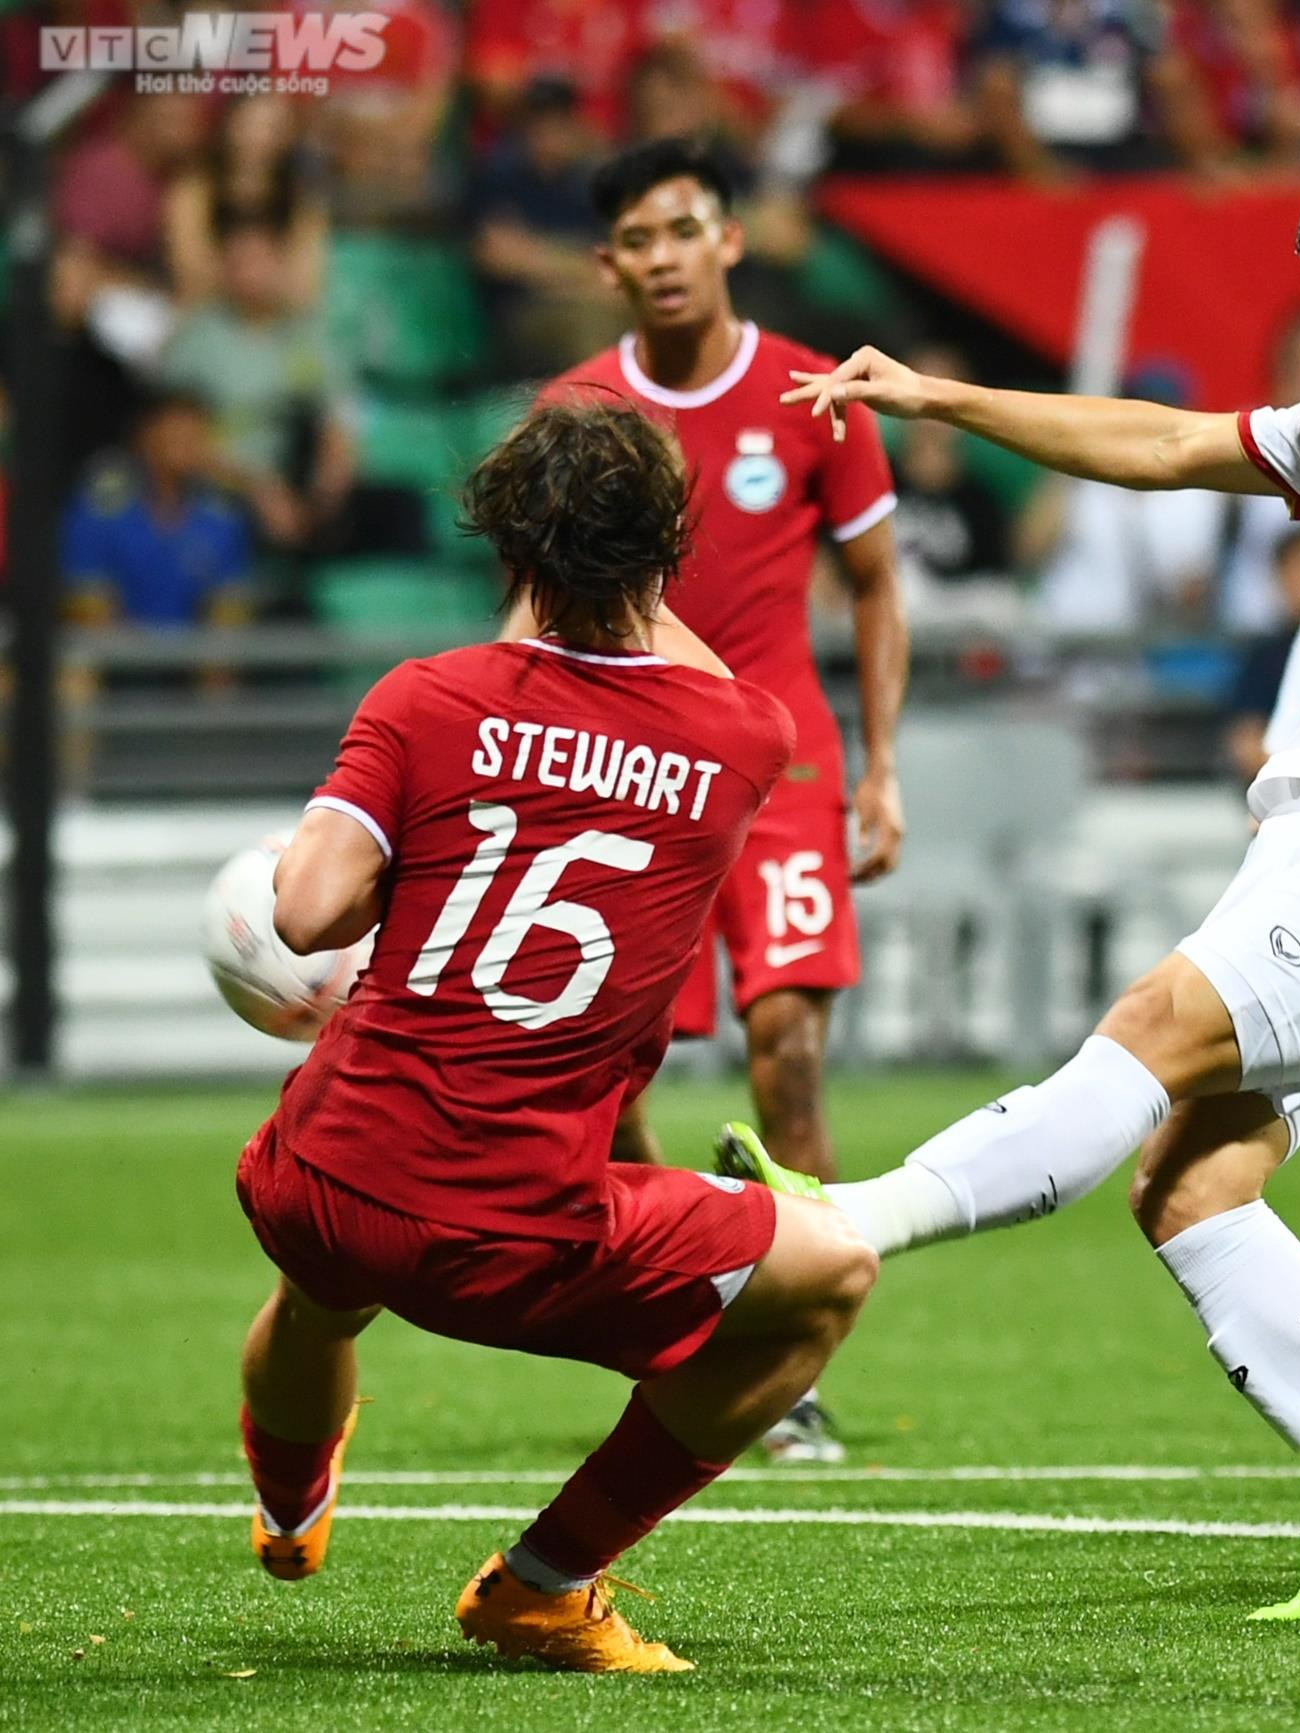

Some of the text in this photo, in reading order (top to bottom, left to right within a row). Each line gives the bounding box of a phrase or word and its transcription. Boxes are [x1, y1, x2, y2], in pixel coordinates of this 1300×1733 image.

[471, 717, 721, 821] STEWART
[406, 799, 655, 1030] 16
[758, 850, 834, 938] 15
